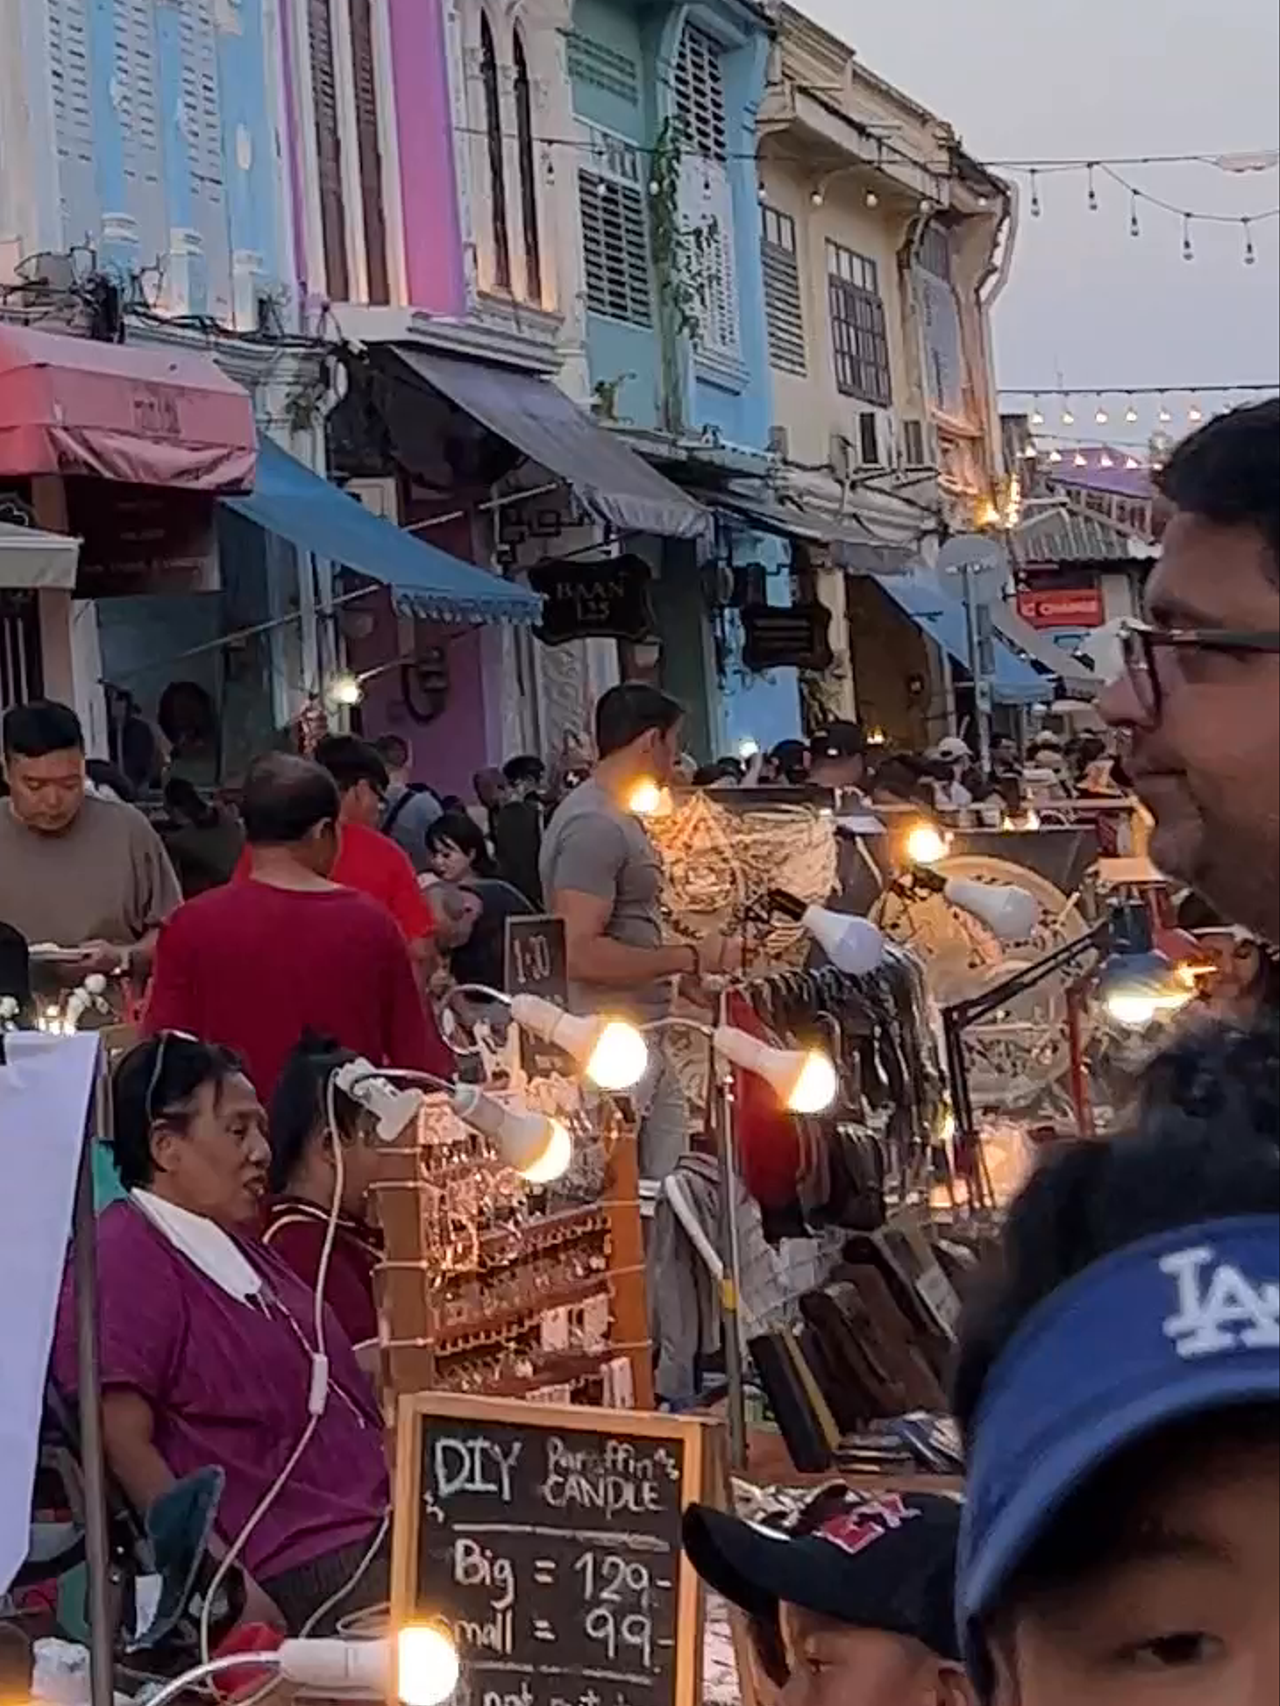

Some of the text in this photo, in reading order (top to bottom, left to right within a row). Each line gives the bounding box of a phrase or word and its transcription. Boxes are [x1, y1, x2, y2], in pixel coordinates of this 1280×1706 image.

[555, 580, 625, 602] BAAN
[1158, 1246, 1280, 1359] LA
[434, 1436, 523, 1502] DIY
[542, 1473, 668, 1520] CANDLE
[453, 1537, 516, 1611] Big
